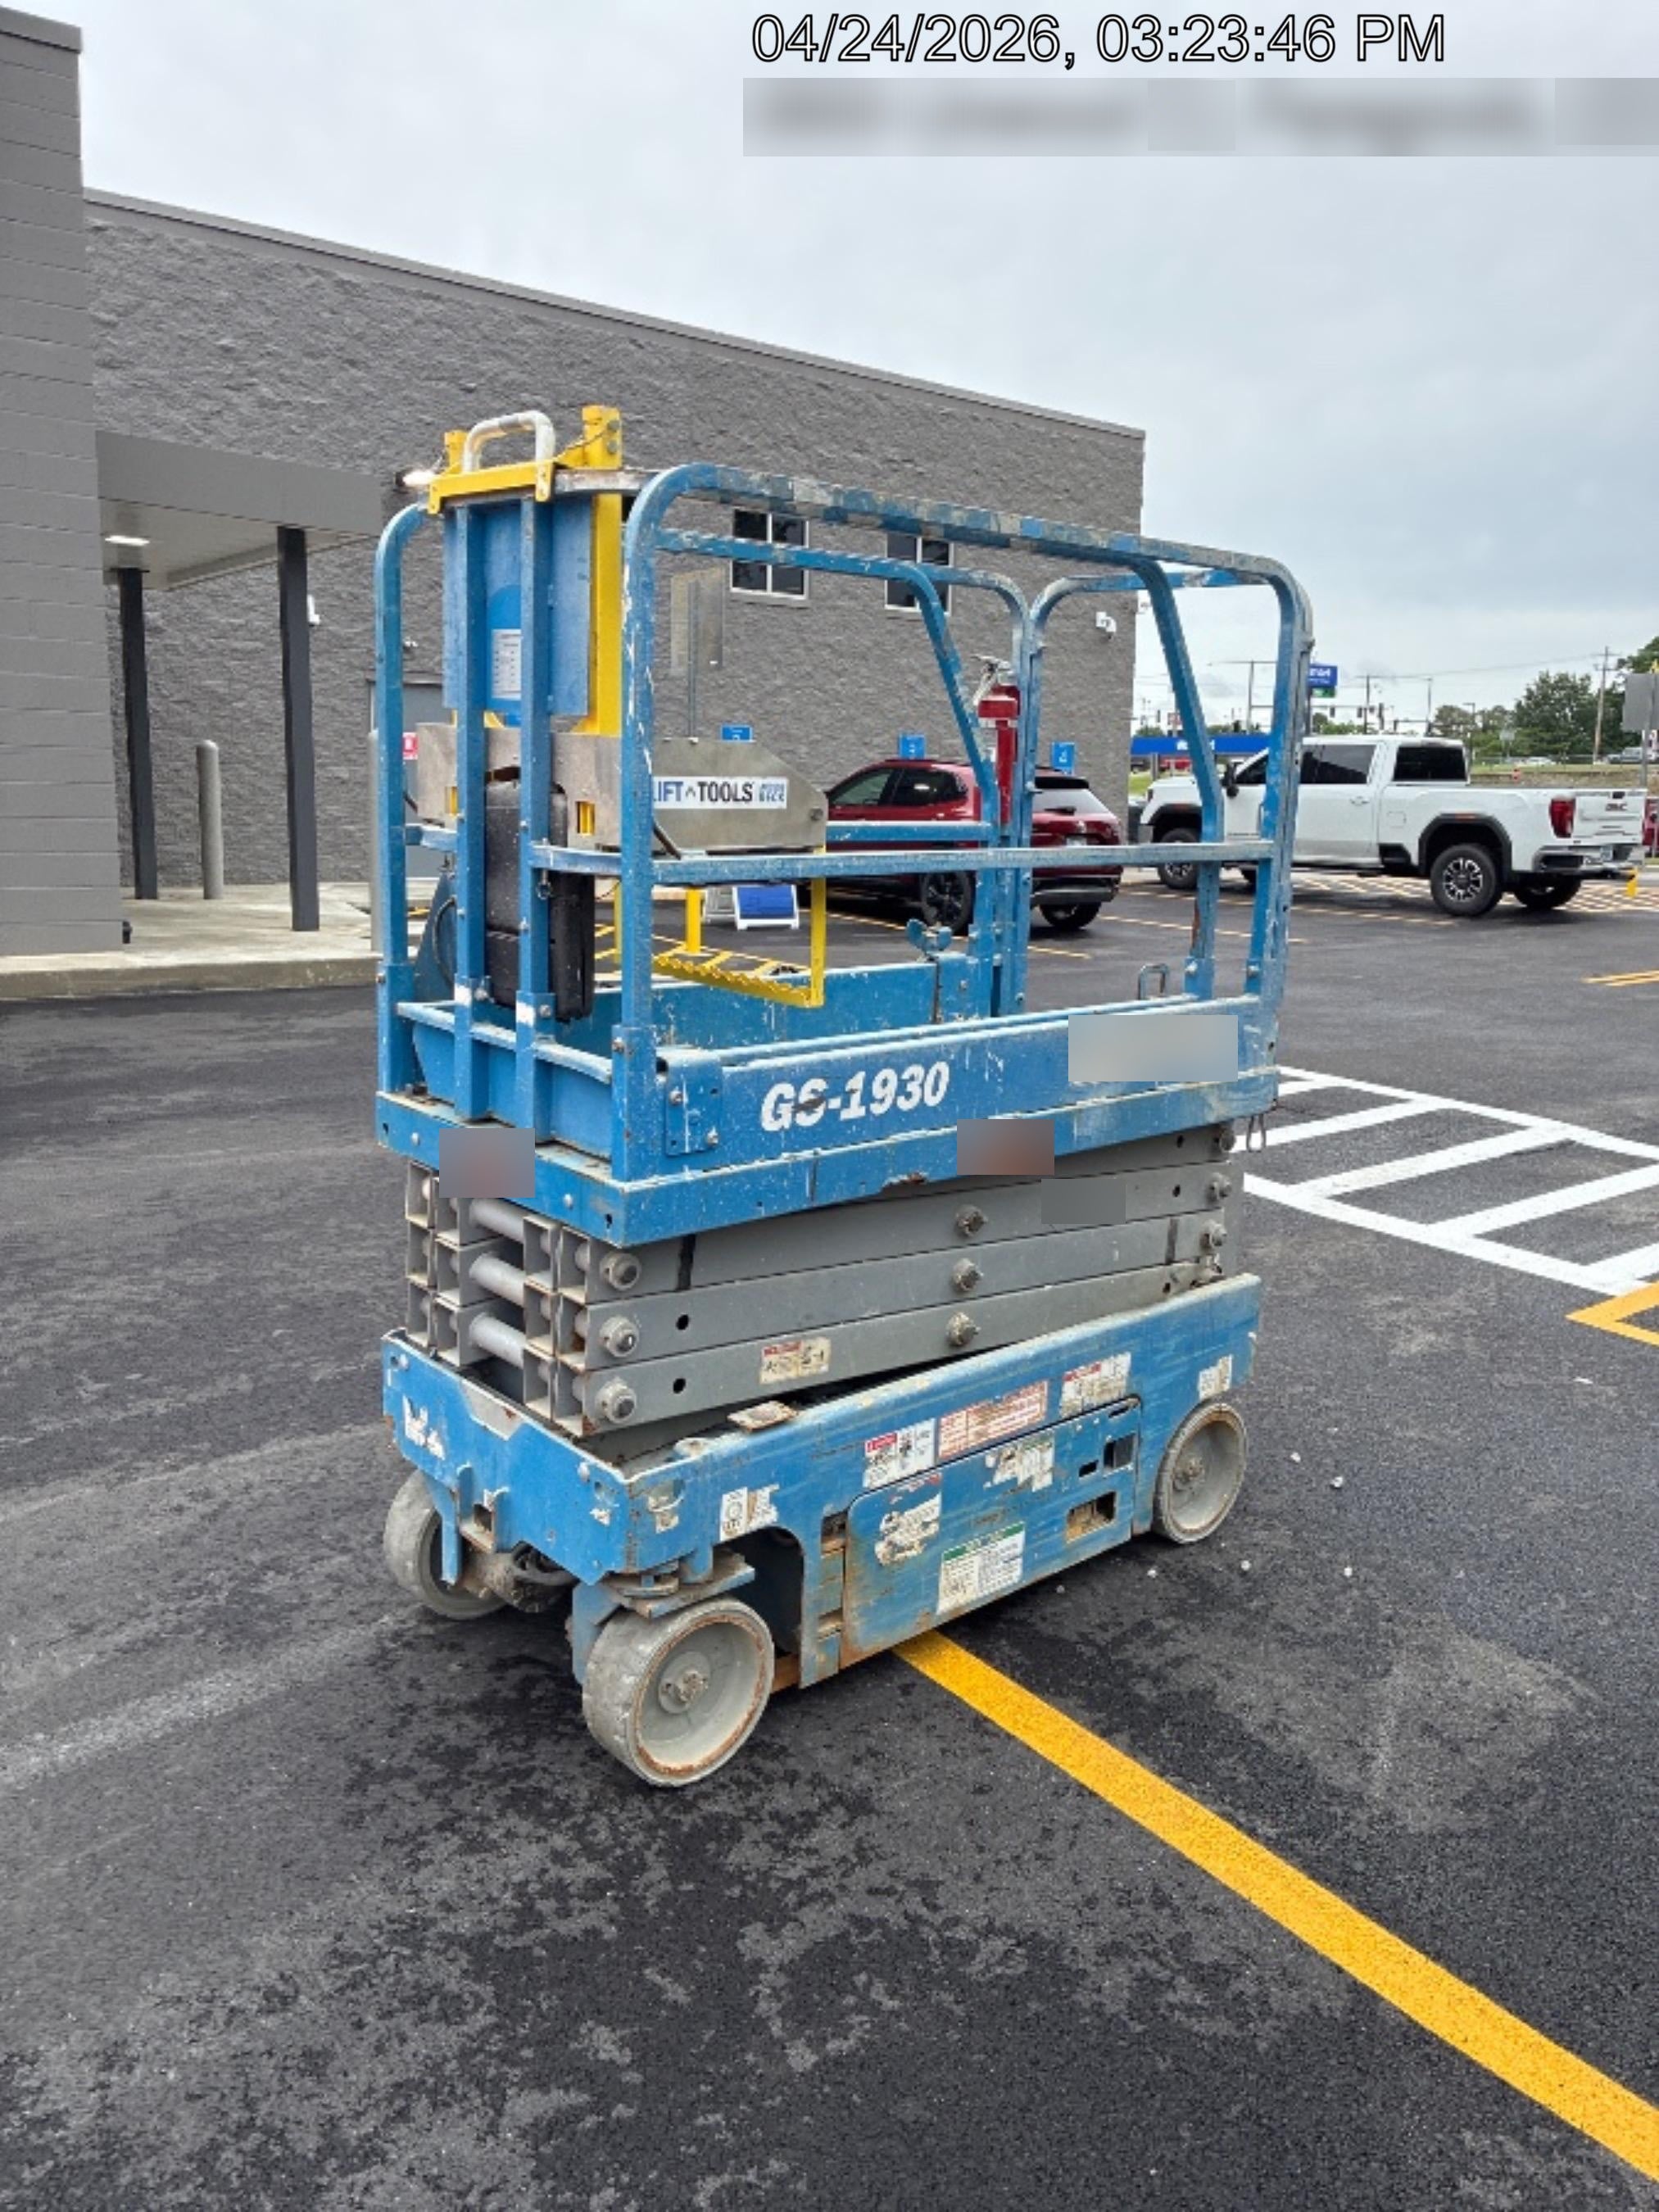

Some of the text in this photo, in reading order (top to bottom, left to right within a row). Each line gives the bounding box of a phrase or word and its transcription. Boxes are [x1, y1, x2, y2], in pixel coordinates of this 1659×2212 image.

[654, 781, 684, 802] IFT
[697, 781, 753, 803] TOOLS
[760, 1061, 950, 1132] GS-1930
